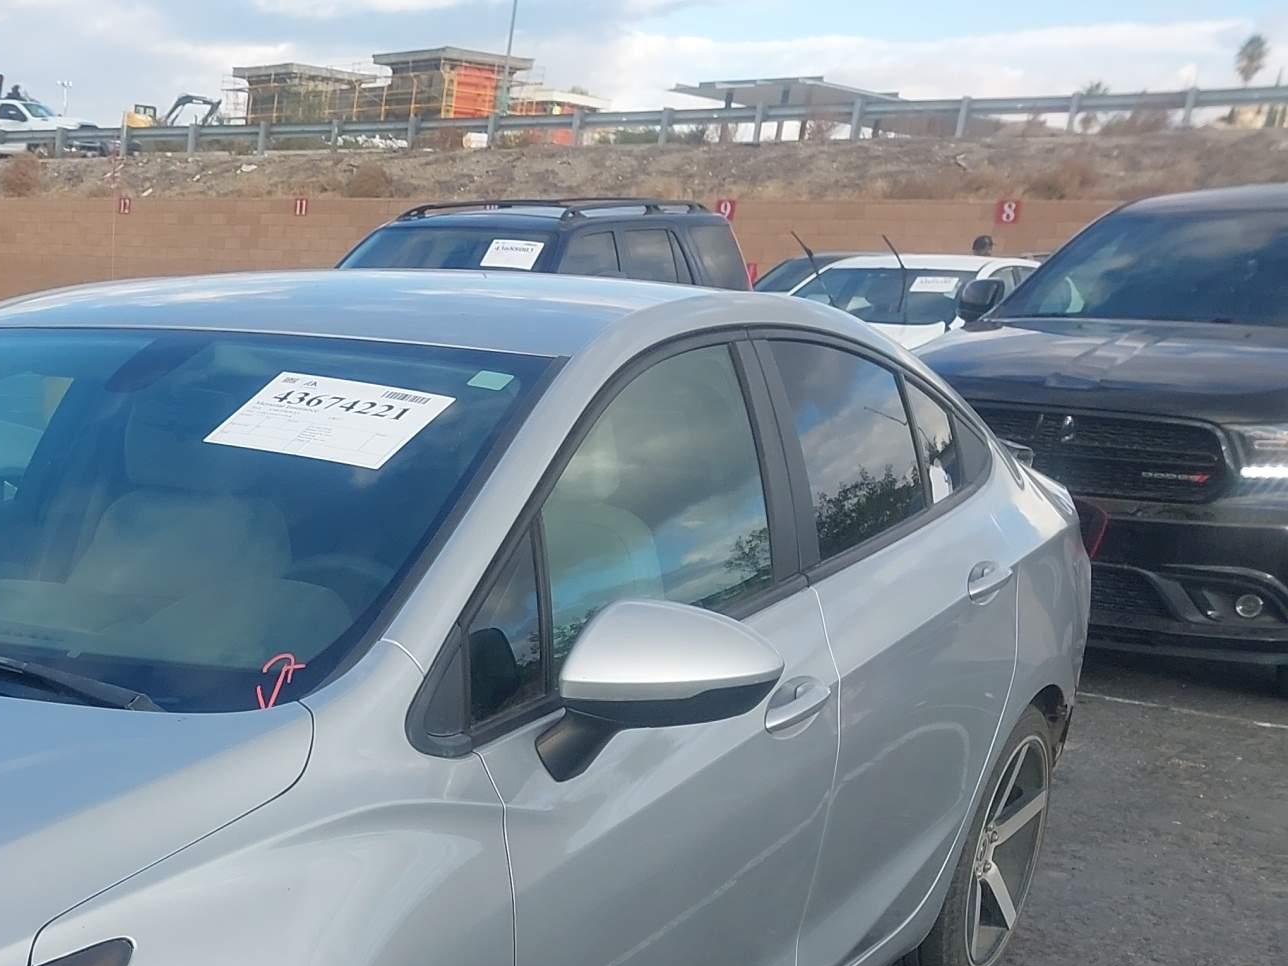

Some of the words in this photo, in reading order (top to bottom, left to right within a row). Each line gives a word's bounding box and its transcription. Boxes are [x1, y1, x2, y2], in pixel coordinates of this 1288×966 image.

[296, 200, 306, 215] 11
[720, 200, 732, 218] 9
[1002, 201, 1017, 222] 8
[274, 390, 412, 421] 43674221
